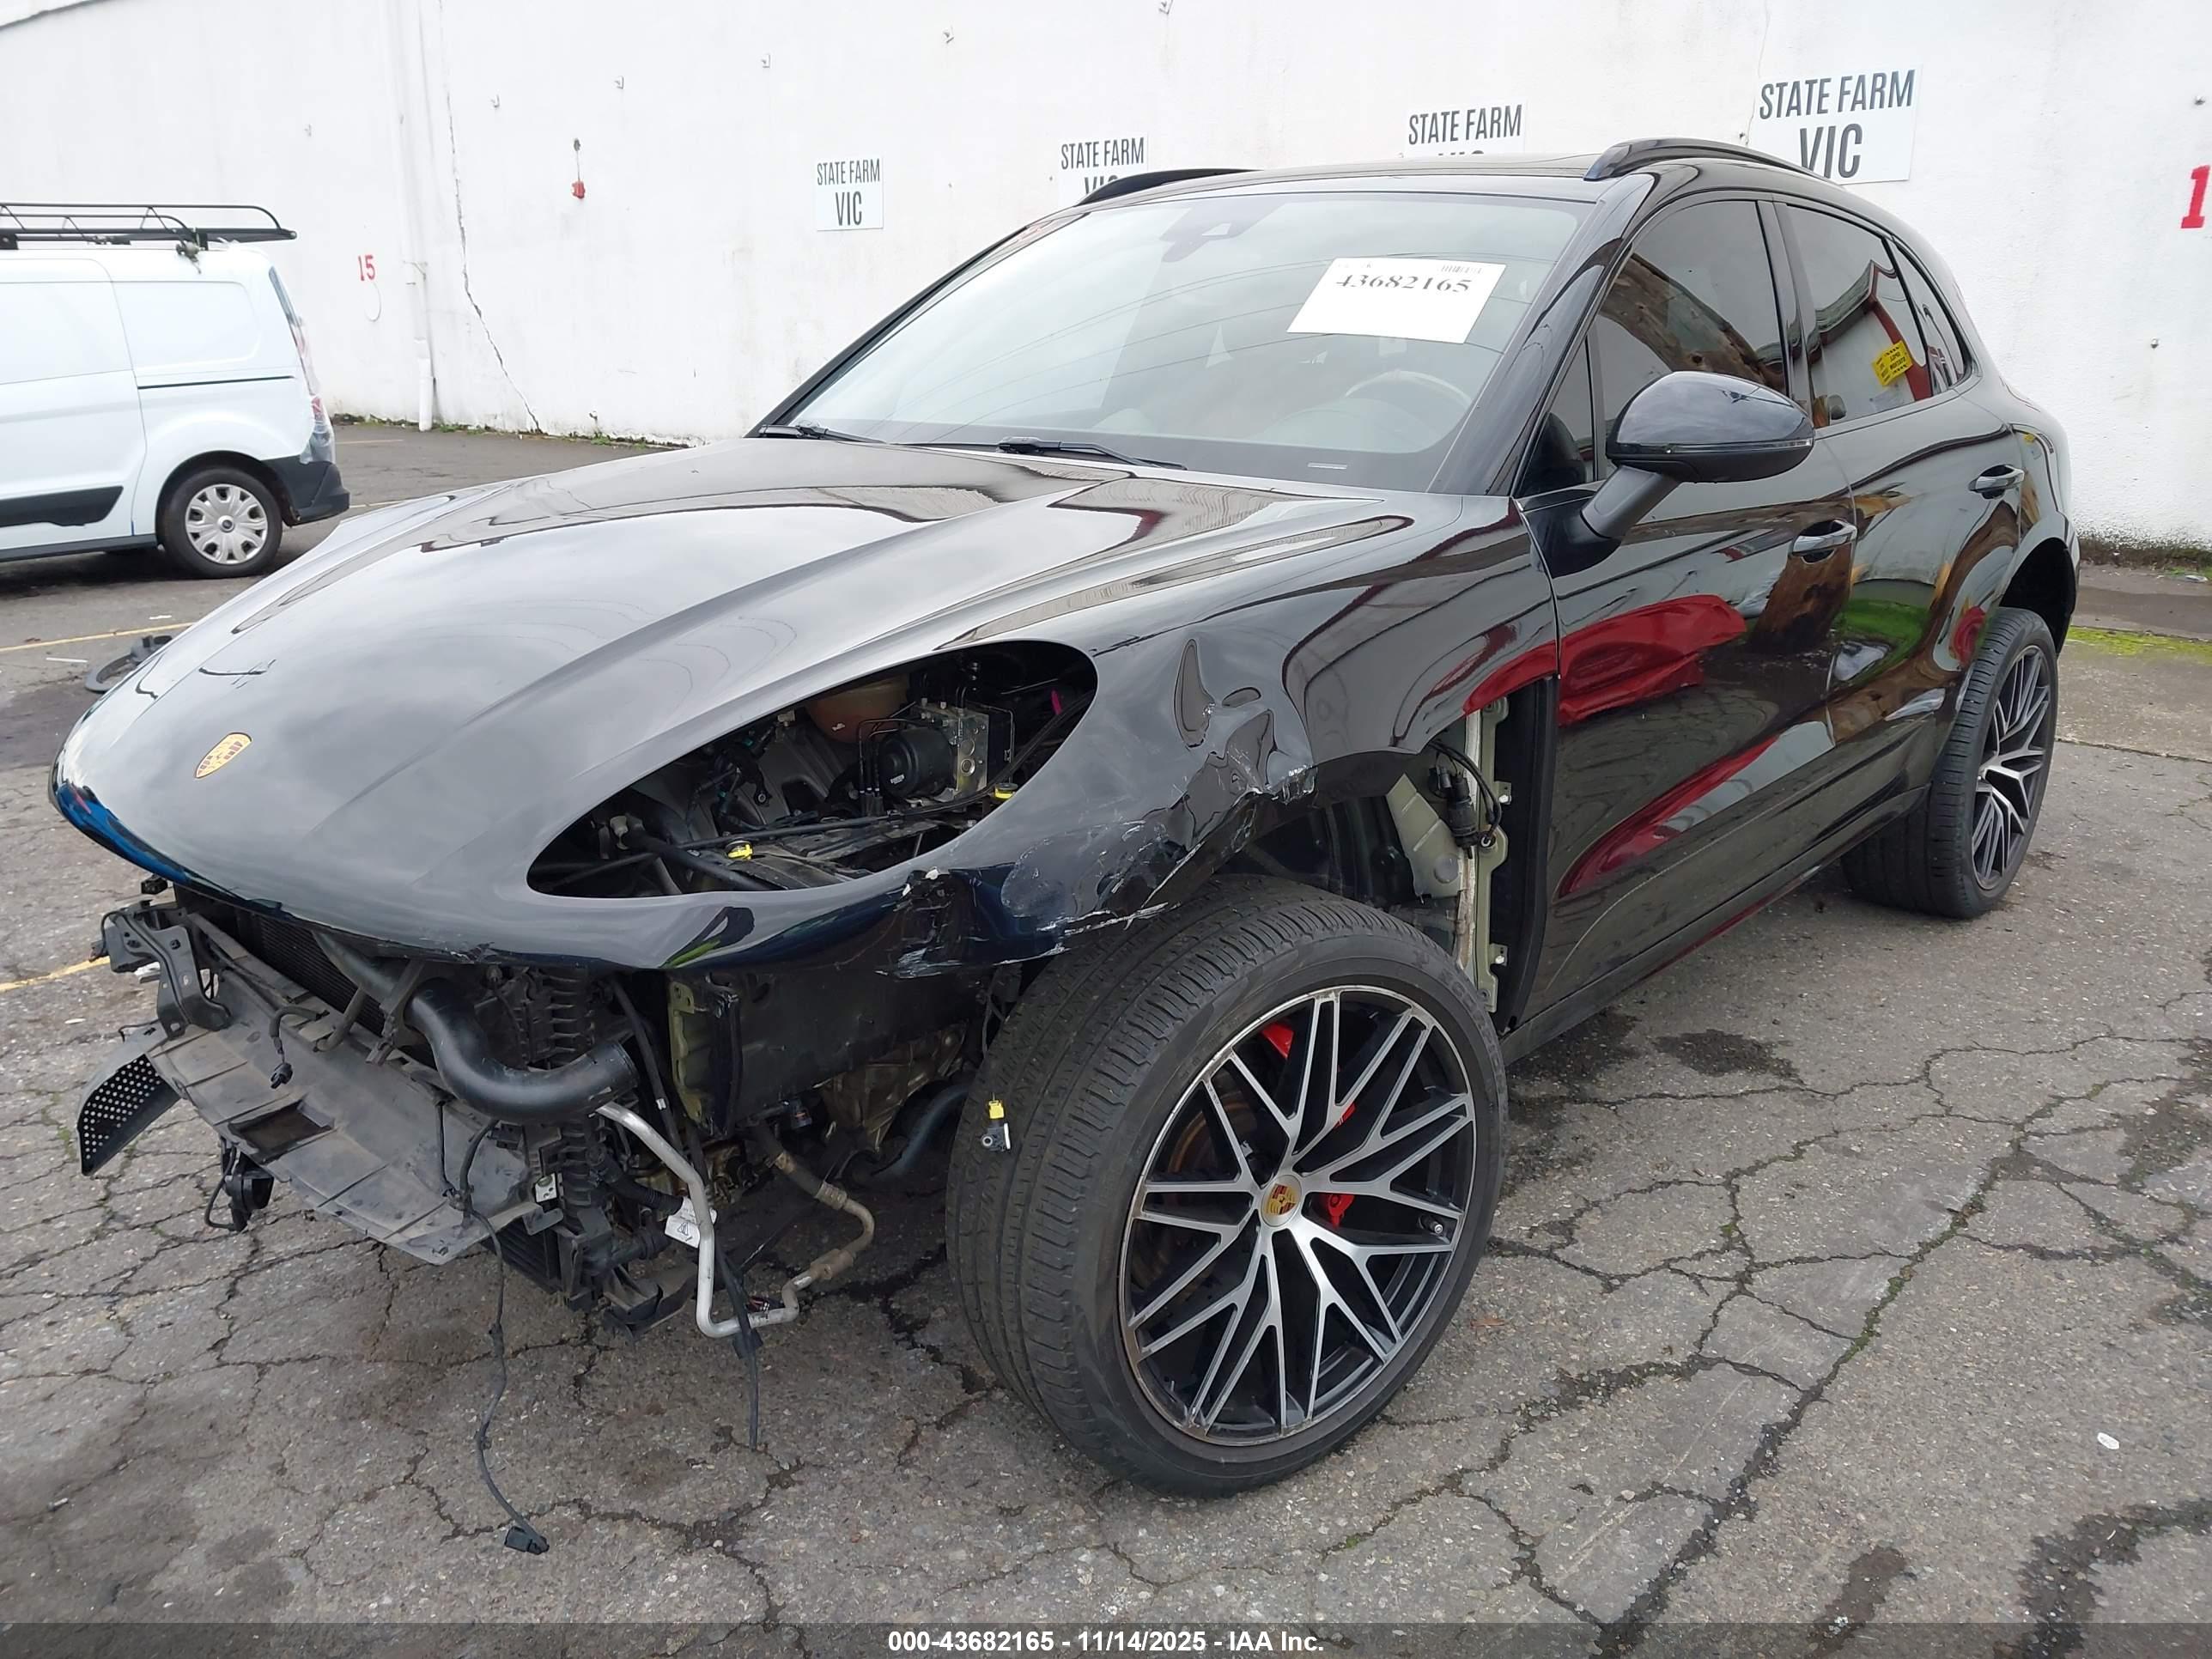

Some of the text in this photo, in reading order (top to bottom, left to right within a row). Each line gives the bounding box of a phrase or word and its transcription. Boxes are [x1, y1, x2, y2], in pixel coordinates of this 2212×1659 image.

[1759, 69, 1916, 120] STATE FARM
[1408, 104, 1522, 145] STATE FARM
[1061, 137, 1145, 170] STATE FARM
[1800, 123, 1863, 179] VIC
[817, 158, 880, 185] STATE FARM
[835, 191, 862, 226] VIC
[357, 254, 376, 282] 15
[1336, 274, 1473, 293] 43682165
